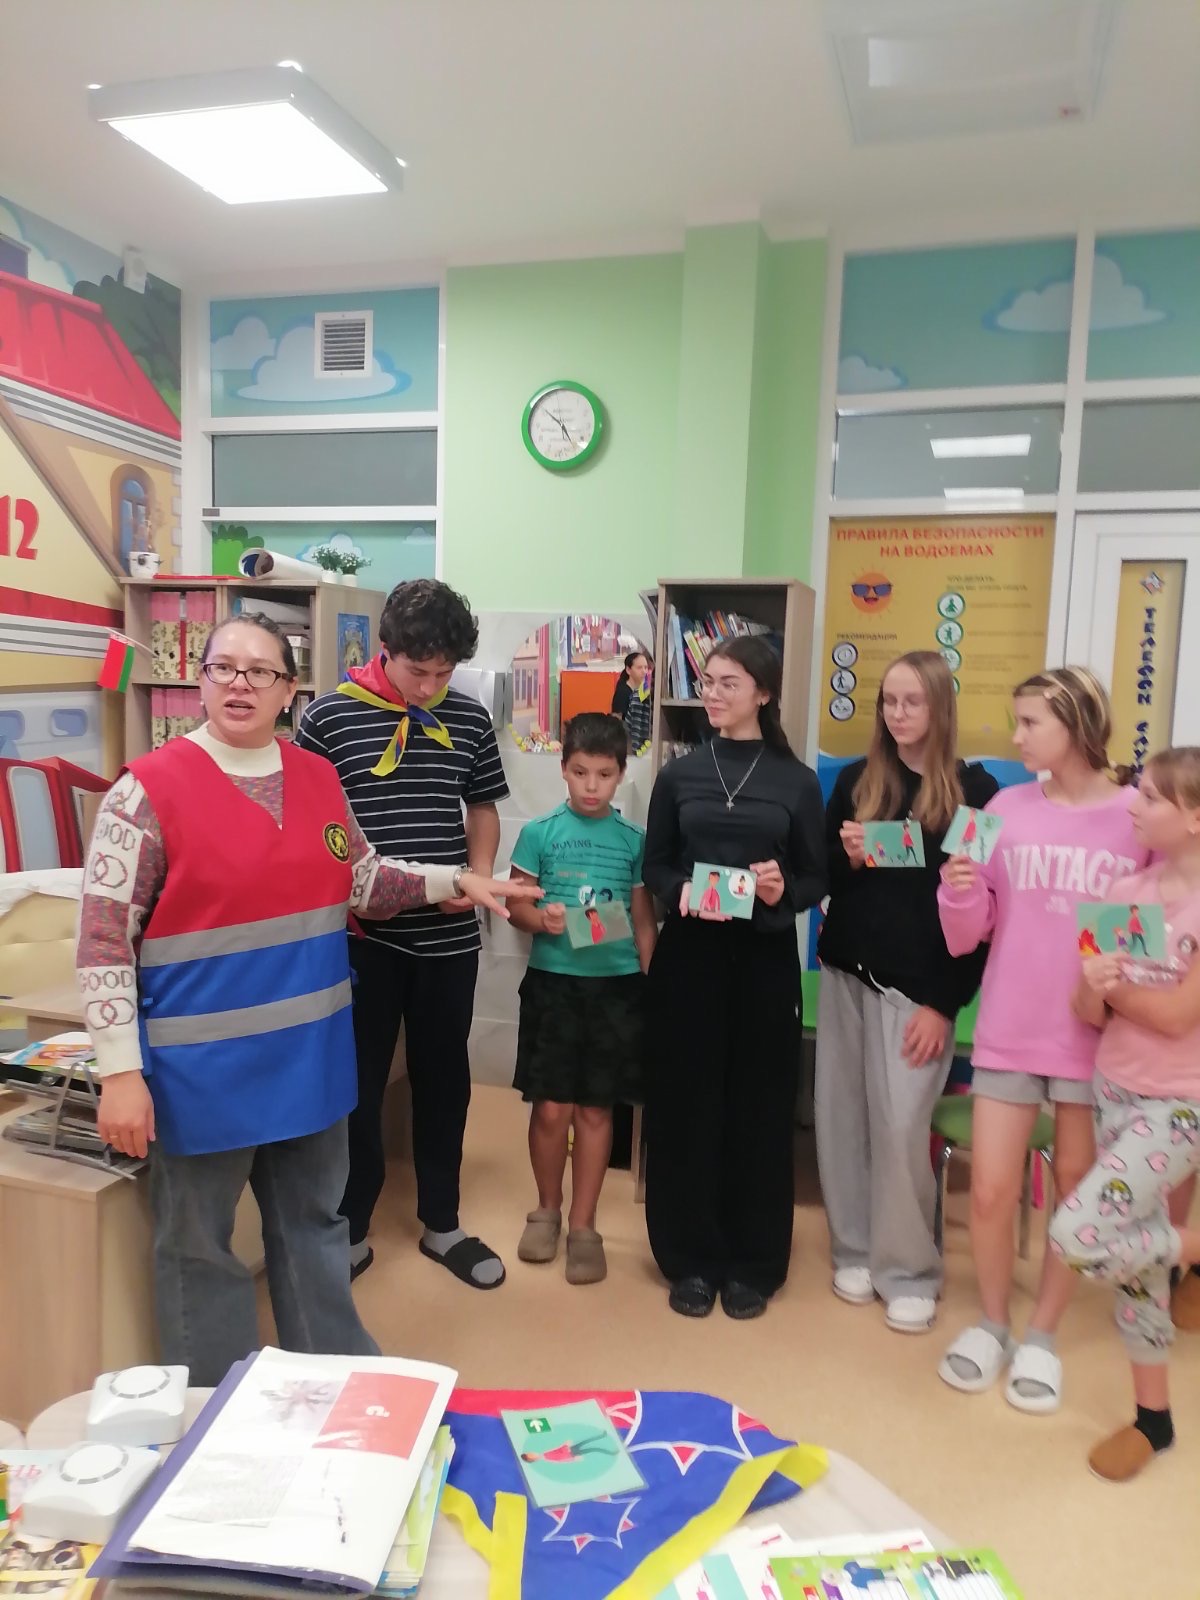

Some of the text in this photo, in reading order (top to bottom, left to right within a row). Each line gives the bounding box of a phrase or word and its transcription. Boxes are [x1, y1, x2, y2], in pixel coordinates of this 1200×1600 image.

[836, 525, 1045, 541] ПРАВИЛА БЕЗОПАСНОСТИ
[879, 544, 994, 559] НА ВОДОЕМАХ
